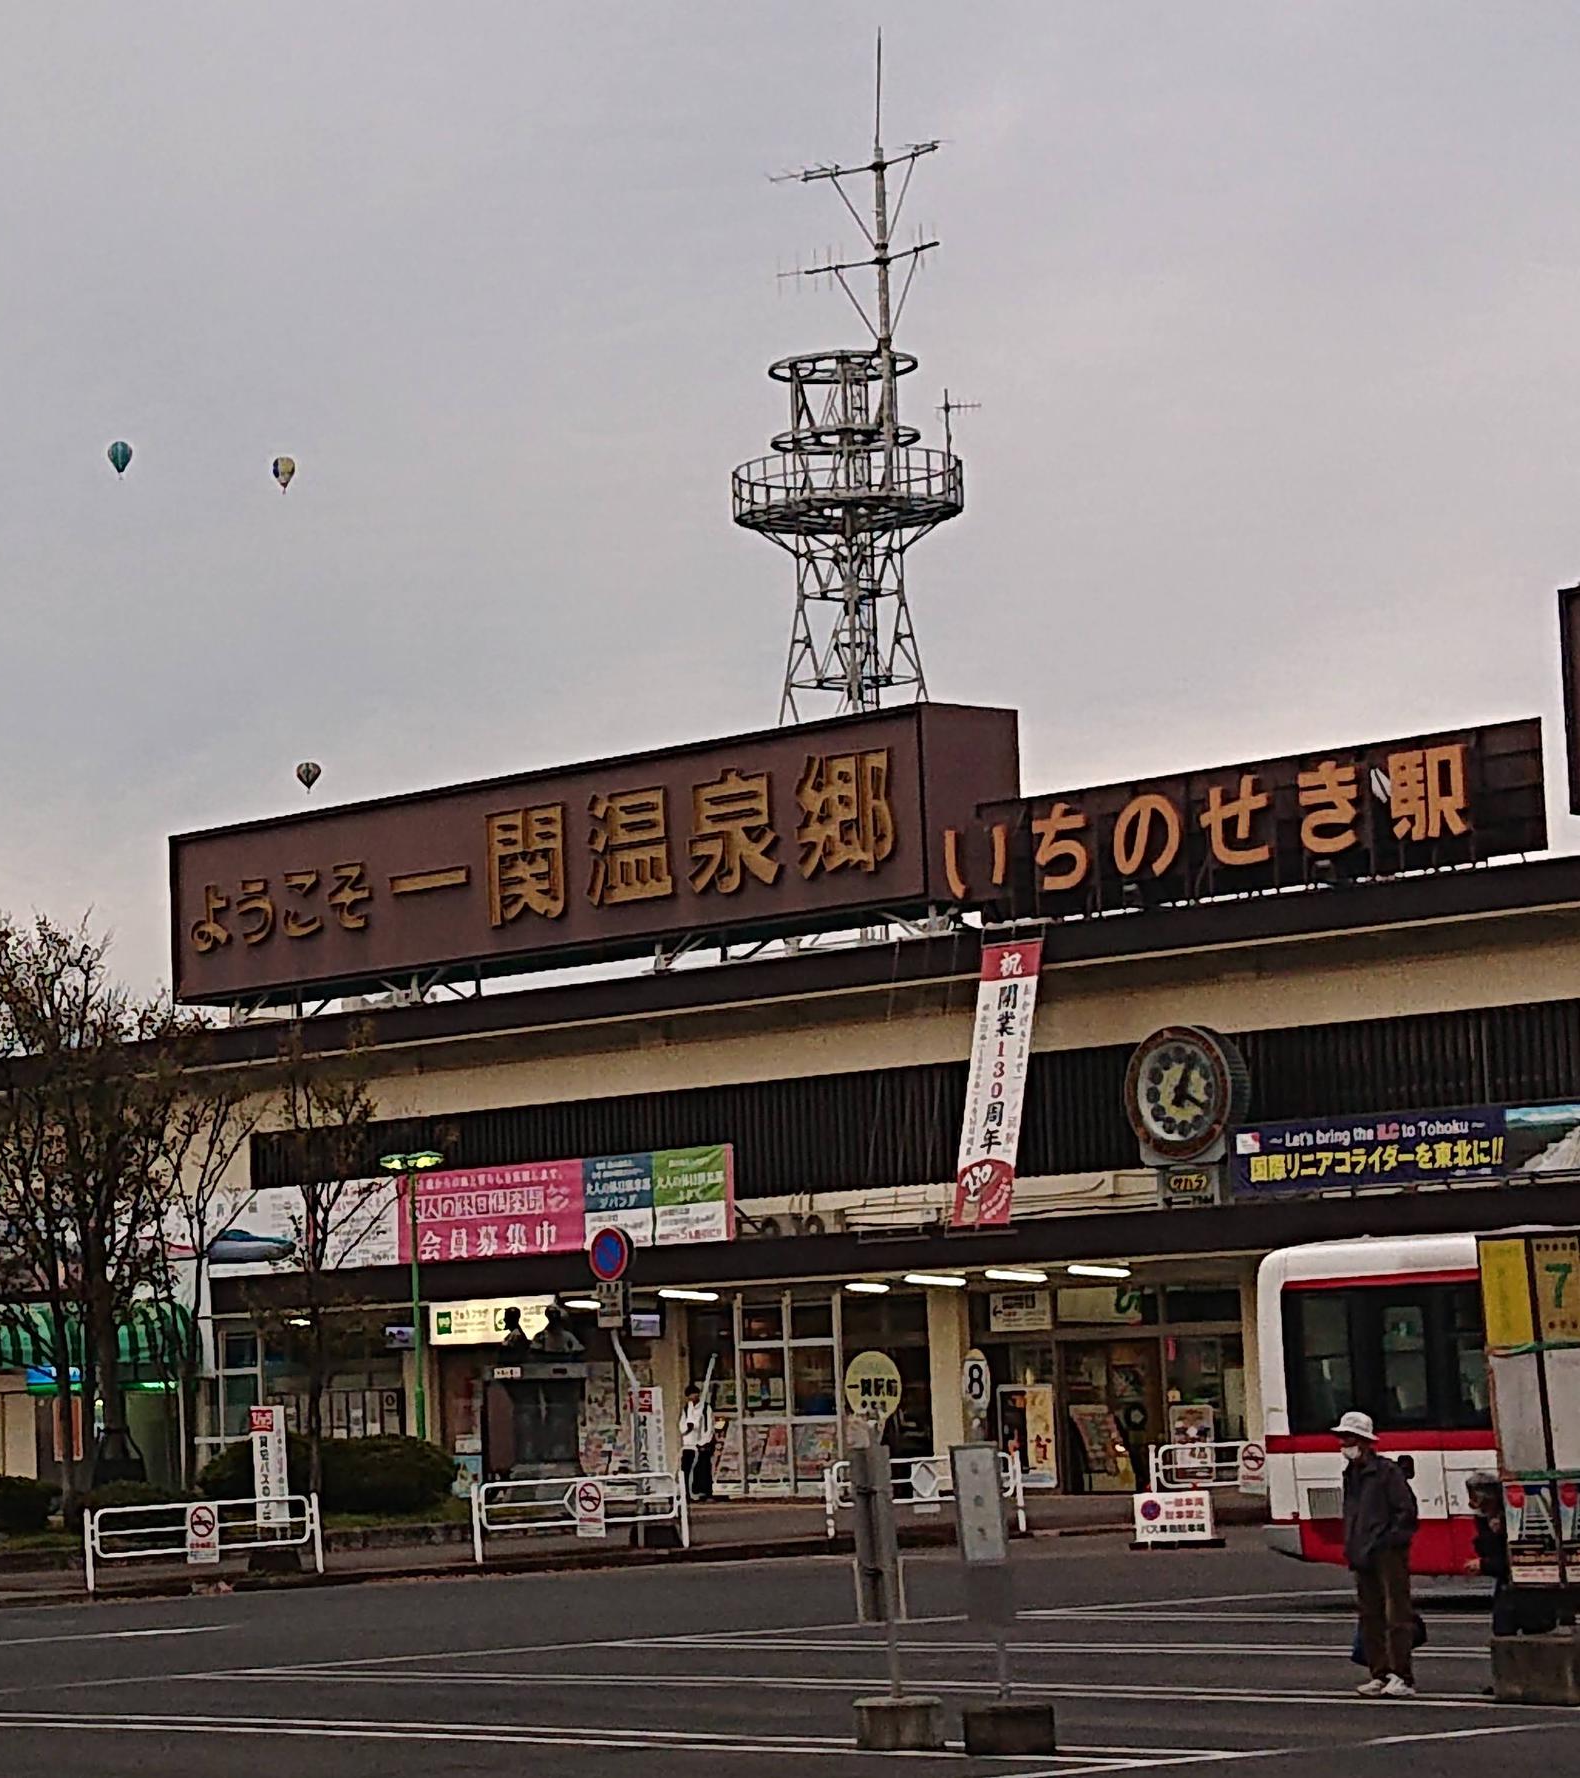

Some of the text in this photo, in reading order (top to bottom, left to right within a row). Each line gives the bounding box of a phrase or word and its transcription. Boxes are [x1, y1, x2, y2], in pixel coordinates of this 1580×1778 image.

[942, 743, 1470, 899] いちのせき駅
[1000, 951, 1024, 977] 祝
[979, 984, 1019, 1155] 開業130周年
[1316, 1129, 1351, 1146] bring
[1353, 1127, 1374, 1141] the
[1402, 1124, 1416, 1138] to
[1418, 1120, 1469, 1137] Tohoku
[421, 1220, 557, 1261] 会員募集中
[1545, 1263, 1573, 1309] 7
[968, 1363, 984, 1400] 8
